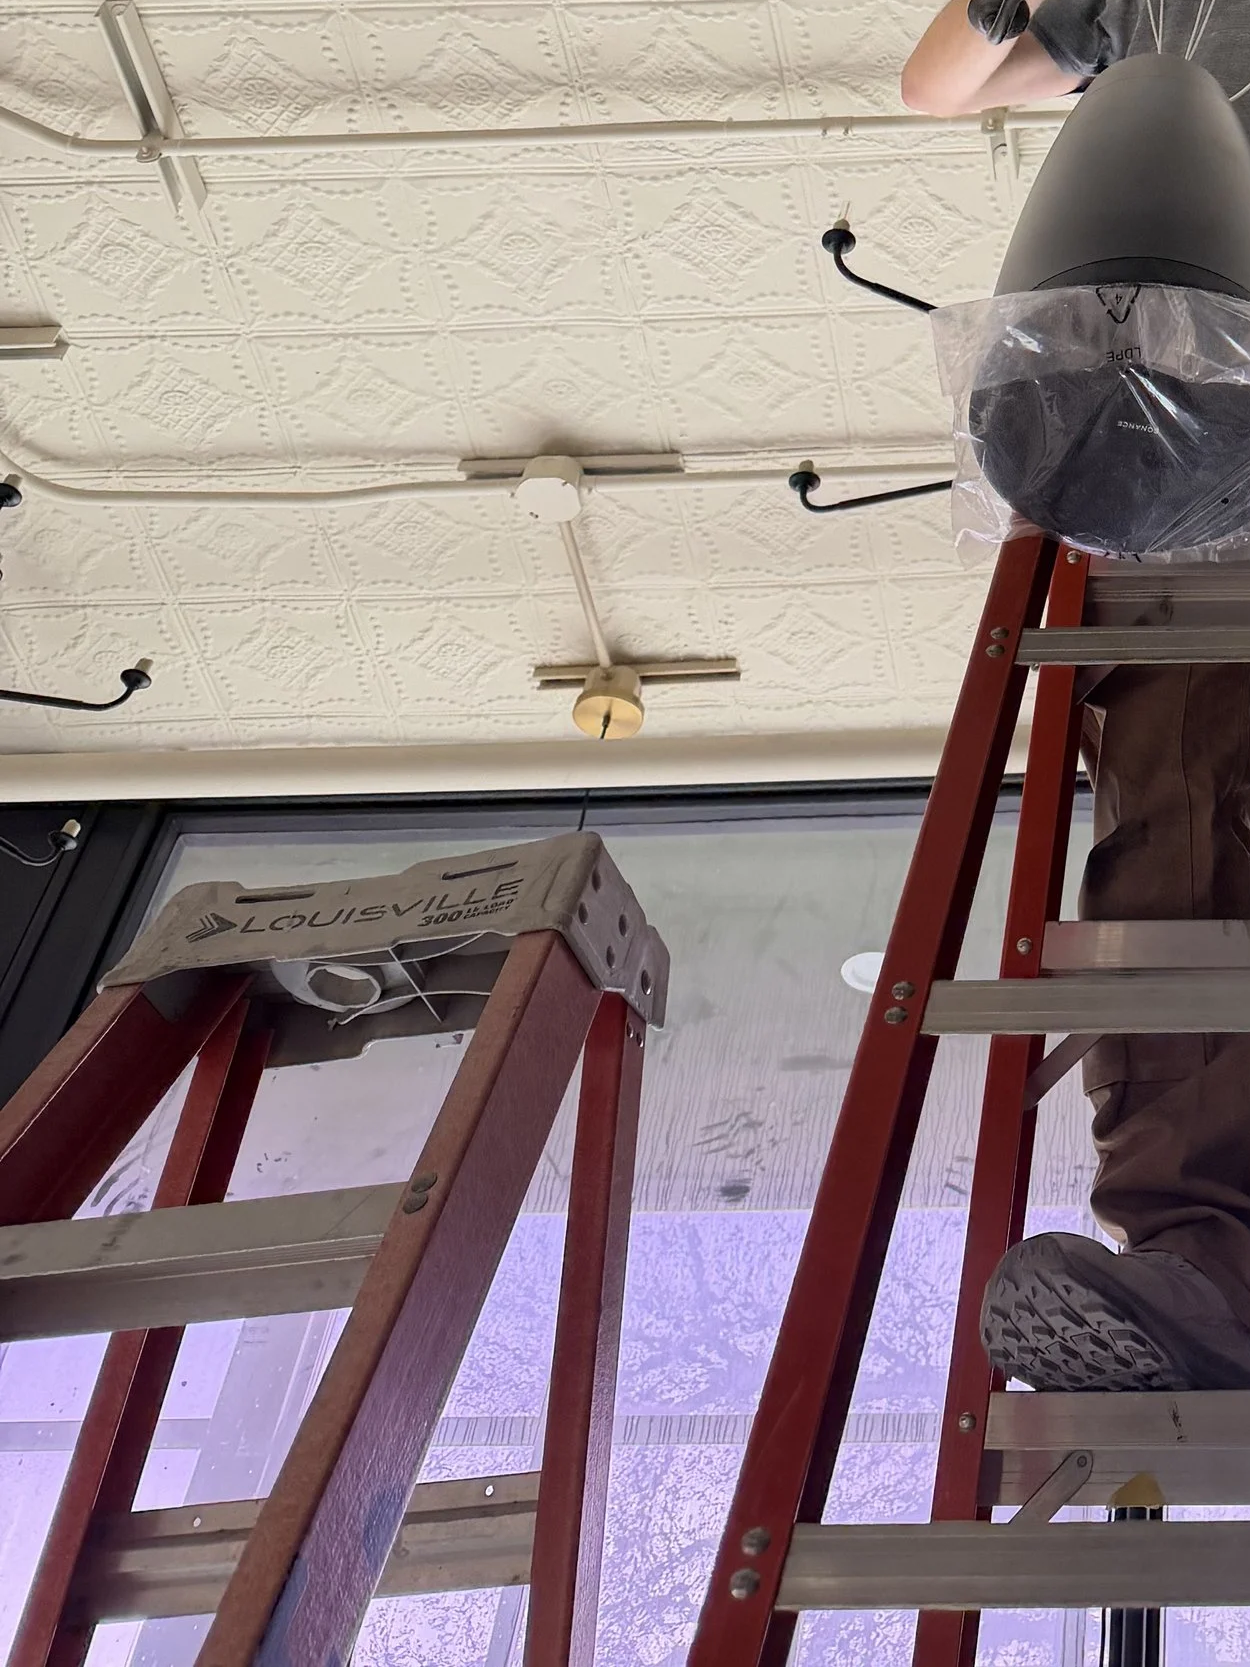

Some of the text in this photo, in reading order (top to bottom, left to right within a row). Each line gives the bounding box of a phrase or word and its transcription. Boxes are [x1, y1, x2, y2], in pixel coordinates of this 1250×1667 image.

[1115, 294, 1123, 305] 4
[1106, 347, 1141, 363] LDPE
[241, 879, 524, 934] LOUISVILLE
[417, 910, 463, 926] 300
